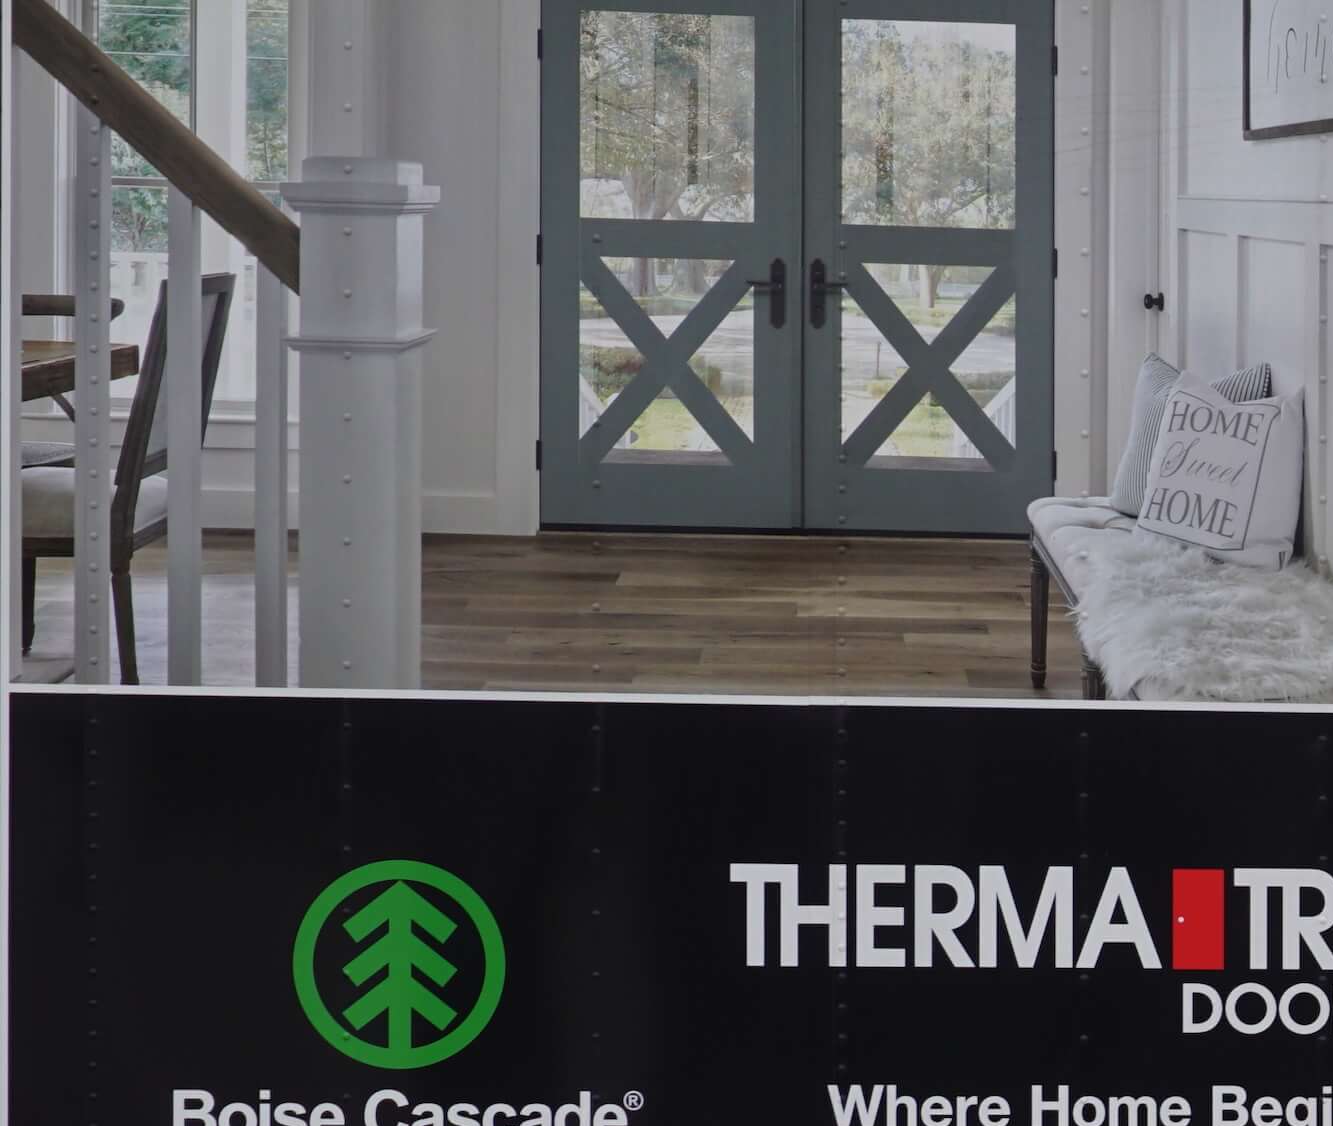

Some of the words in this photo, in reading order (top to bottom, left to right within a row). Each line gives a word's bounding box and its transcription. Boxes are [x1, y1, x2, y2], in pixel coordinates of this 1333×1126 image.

[1168, 401, 1264, 446] HOME
[1144, 487, 1238, 538] HOME
[730, 863, 1162, 969] THERMA
